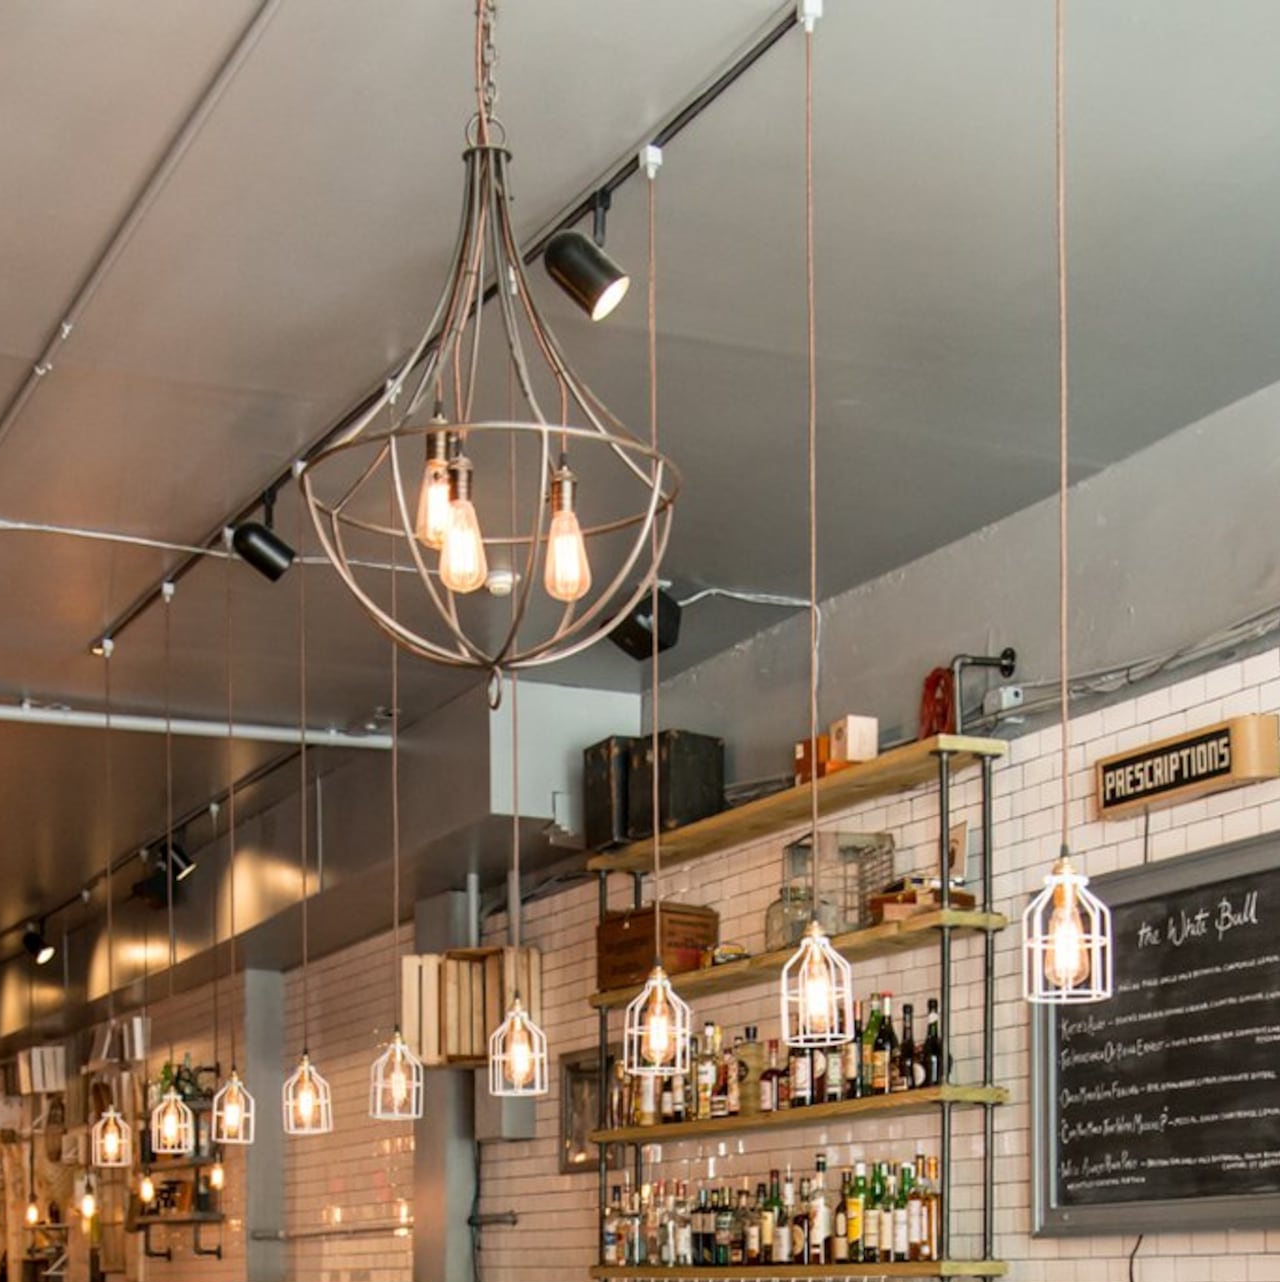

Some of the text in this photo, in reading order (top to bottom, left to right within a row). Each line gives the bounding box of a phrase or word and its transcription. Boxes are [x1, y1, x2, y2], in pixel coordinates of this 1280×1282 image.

[1105, 737, 1230, 801] PRESCRIPTIONS
[1137, 890, 1259, 949] the White Bull
